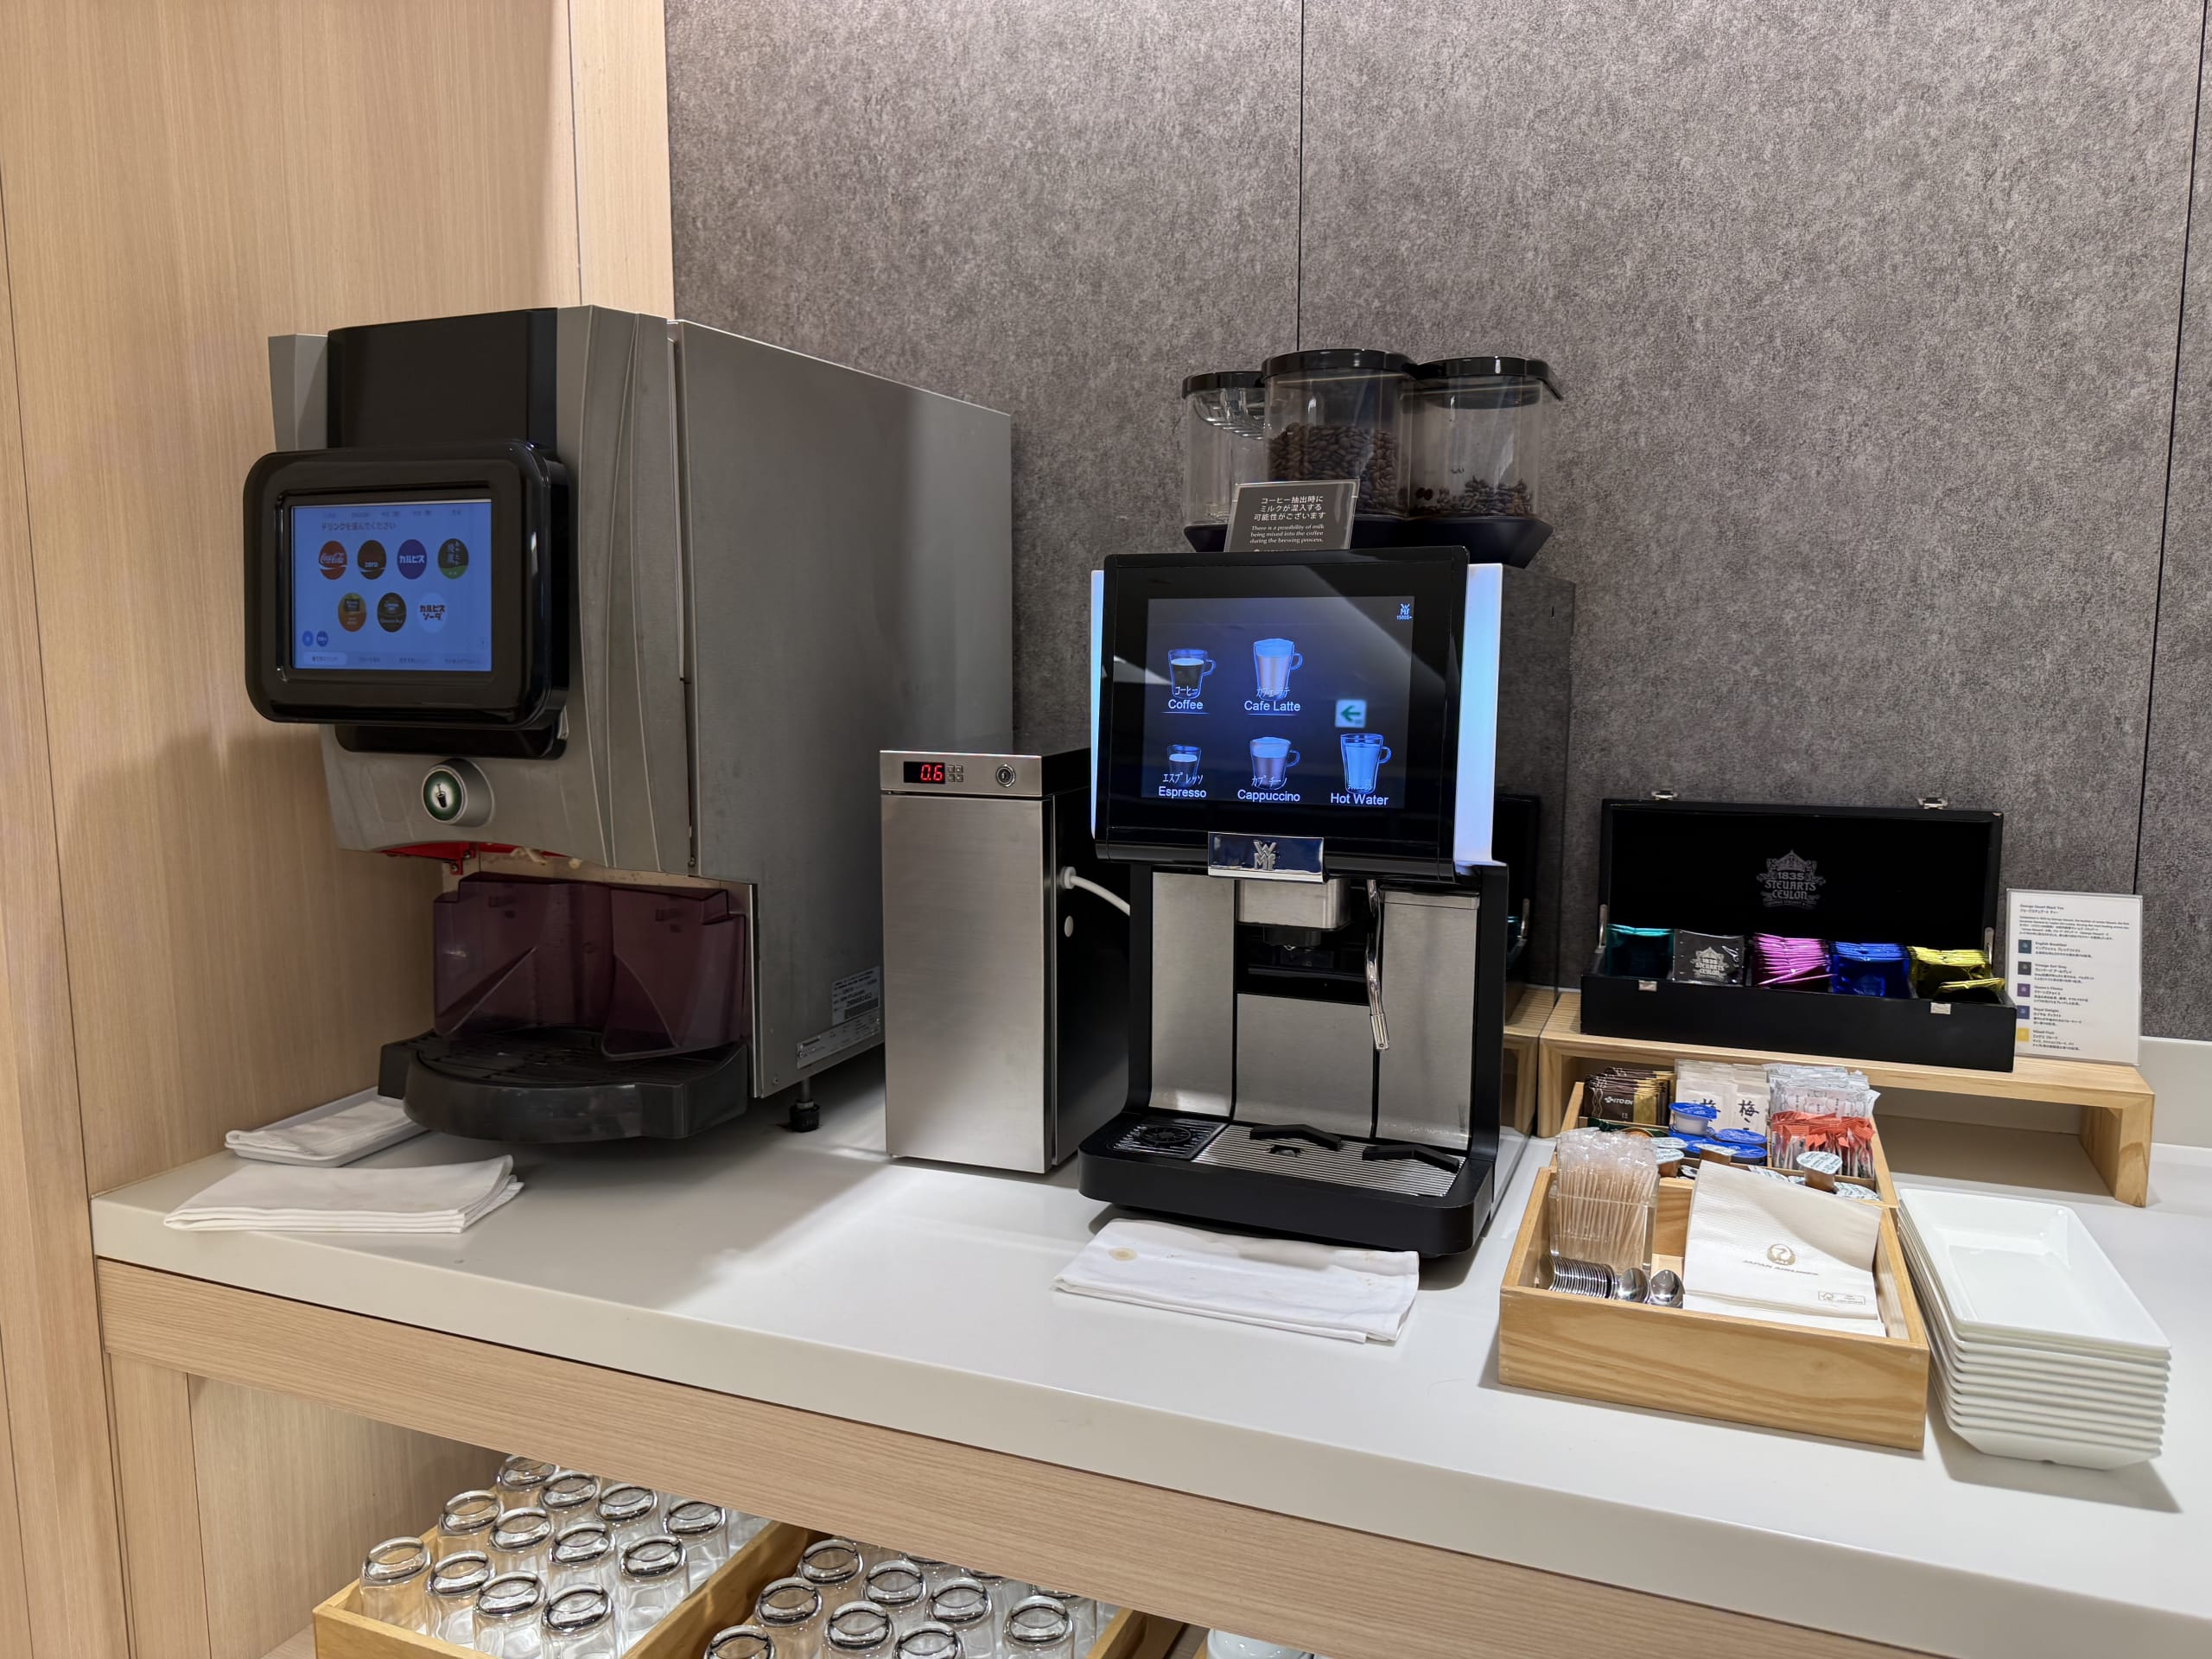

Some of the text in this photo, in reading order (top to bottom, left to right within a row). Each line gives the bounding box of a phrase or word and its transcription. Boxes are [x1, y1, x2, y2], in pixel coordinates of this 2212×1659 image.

[1261, 495, 1324, 504] コーヒー抽出時に
[1260, 504, 1322, 512] ミルクが混入する
[1254, 512, 1326, 521] 可能性がございます
[399, 555, 425, 563] カルピス
[419, 604, 446, 613] カルピス
[1174, 685, 1198, 696] コーヒー
[1168, 698, 1204, 710] Coffee
[1243, 700, 1300, 712] Cafe Latte
[920, 764, 944, 781] 0.6
[1158, 785, 1207, 799] Espresso
[1236, 789, 1301, 803] Cappuccino
[1331, 792, 1389, 805] Hot Water
[1777, 871, 1805, 880] 1835
[1764, 879, 1816, 892] STEUARTS
[1771, 889, 1808, 900] CEYLON
